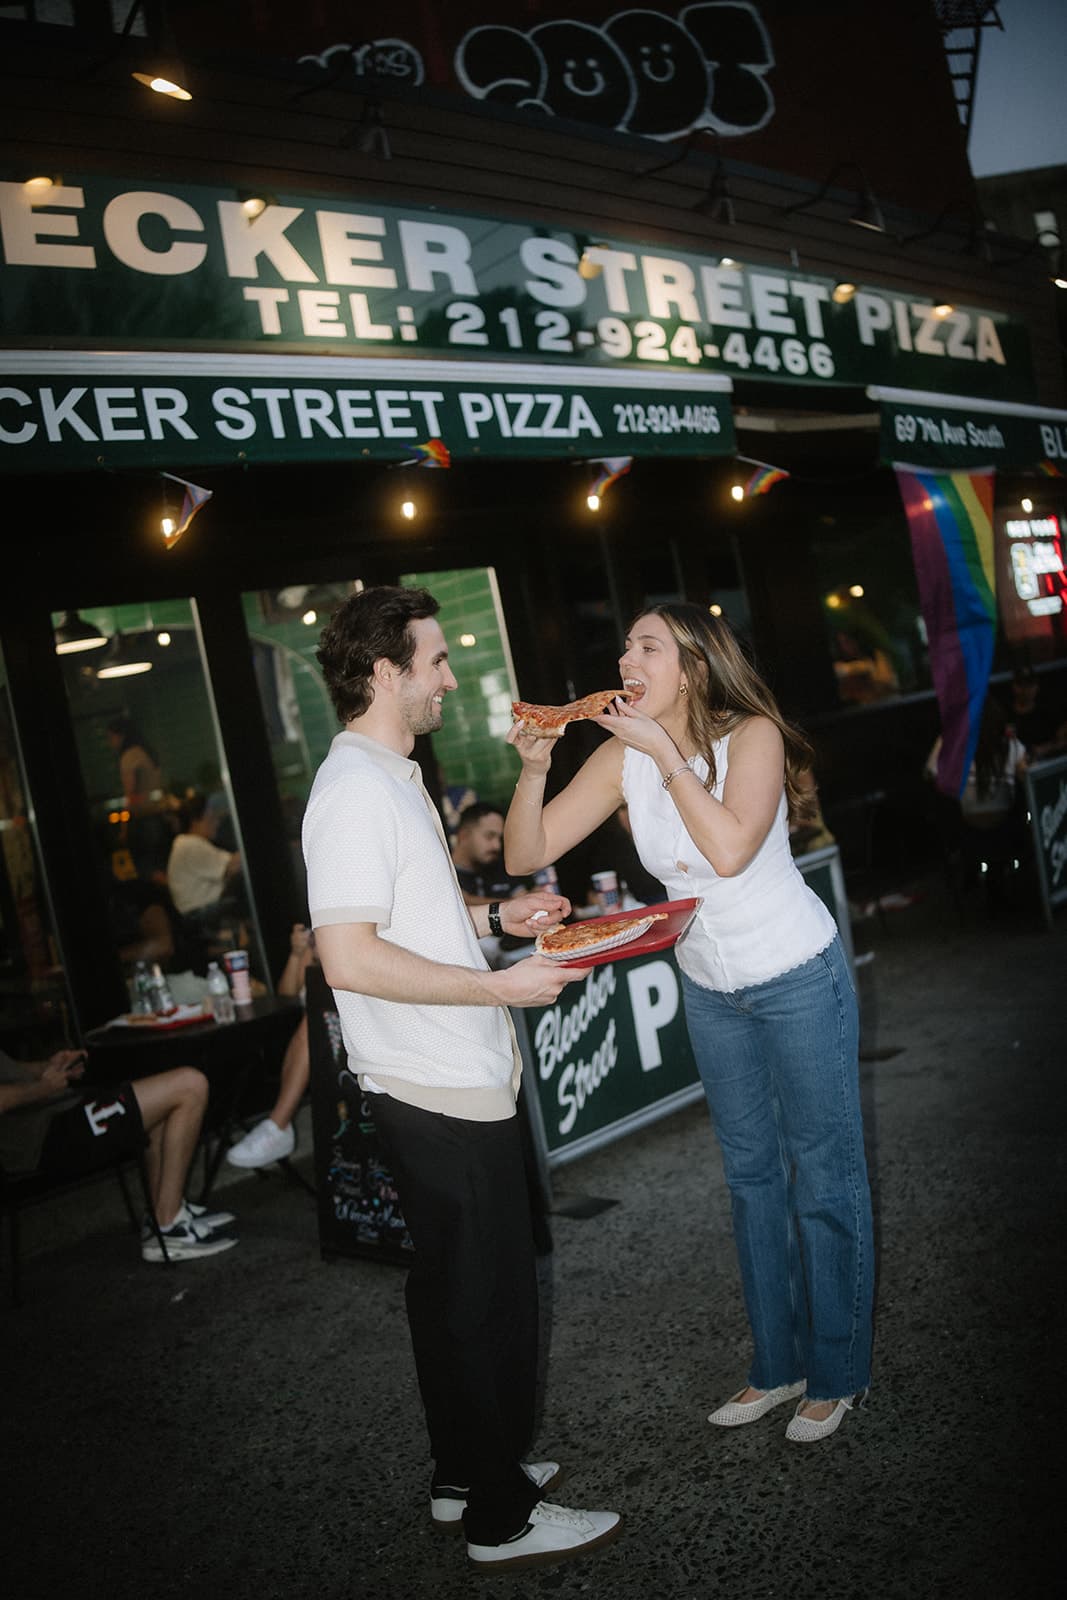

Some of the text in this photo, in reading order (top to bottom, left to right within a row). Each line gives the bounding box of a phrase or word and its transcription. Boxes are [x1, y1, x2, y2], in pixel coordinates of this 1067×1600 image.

[0, 181, 1006, 366] ECKER STREET PIZZA
[243, 286, 835, 379] TEL: 212-924-4466
[0, 387, 721, 444] CKER STREET PIZZA 212-924-4466
[894, 415, 1005, 448] 69 7th Ave South
[558, 1018, 618, 1135] Street
